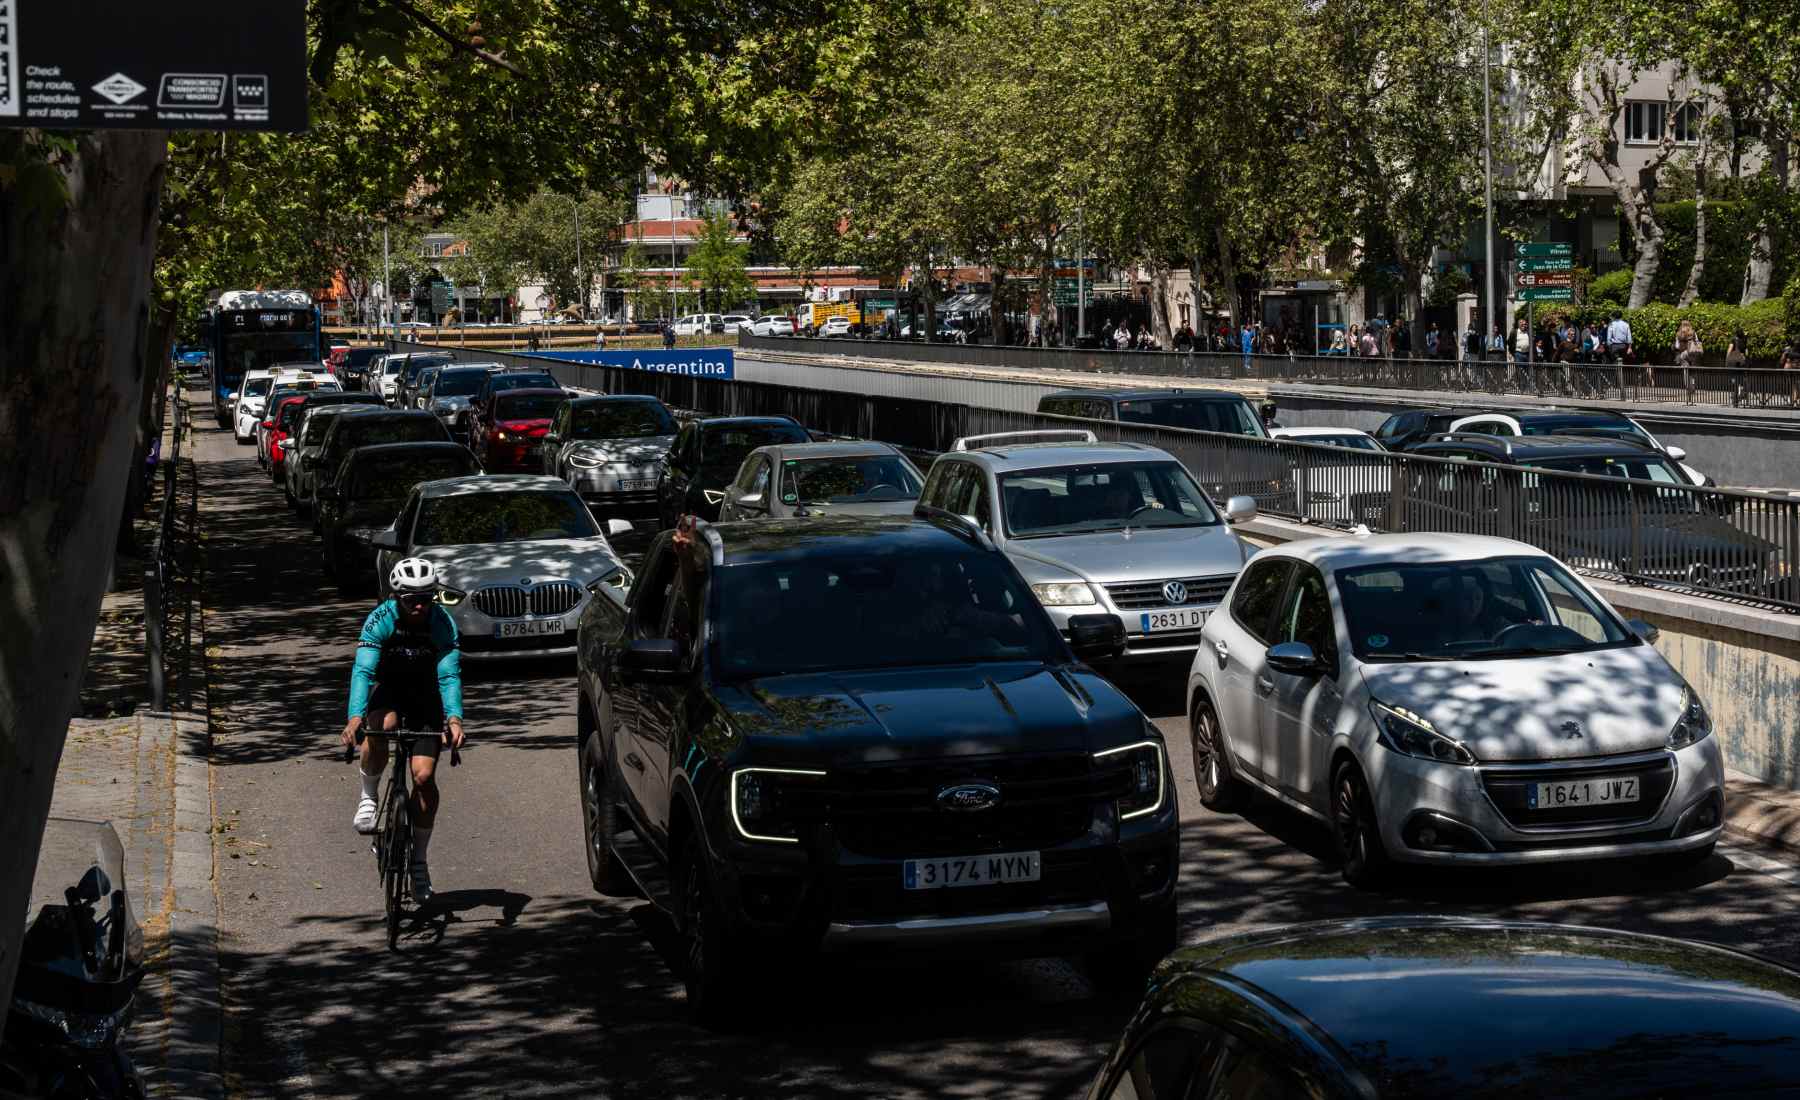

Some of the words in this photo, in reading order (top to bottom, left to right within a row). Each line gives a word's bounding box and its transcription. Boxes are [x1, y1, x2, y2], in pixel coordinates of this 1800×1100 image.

[25, 65, 61, 77] Check
[26, 79, 44, 91] the
[45, 80, 76, 92] route,
[26, 93, 81, 105] schedules
[27, 107, 49, 118] and
[49, 108, 79, 120] stops
[632, 358, 726, 375] Argentina
[503, 621, 535, 635] 8784
[538, 619, 562, 633] LMR
[1151, 613, 1186, 628] 2631
[1545, 783, 1591, 804] 1641
[1600, 780, 1635, 801] JWZ
[924, 860, 981, 884] 3174
[988, 856, 1031, 880] MYN
